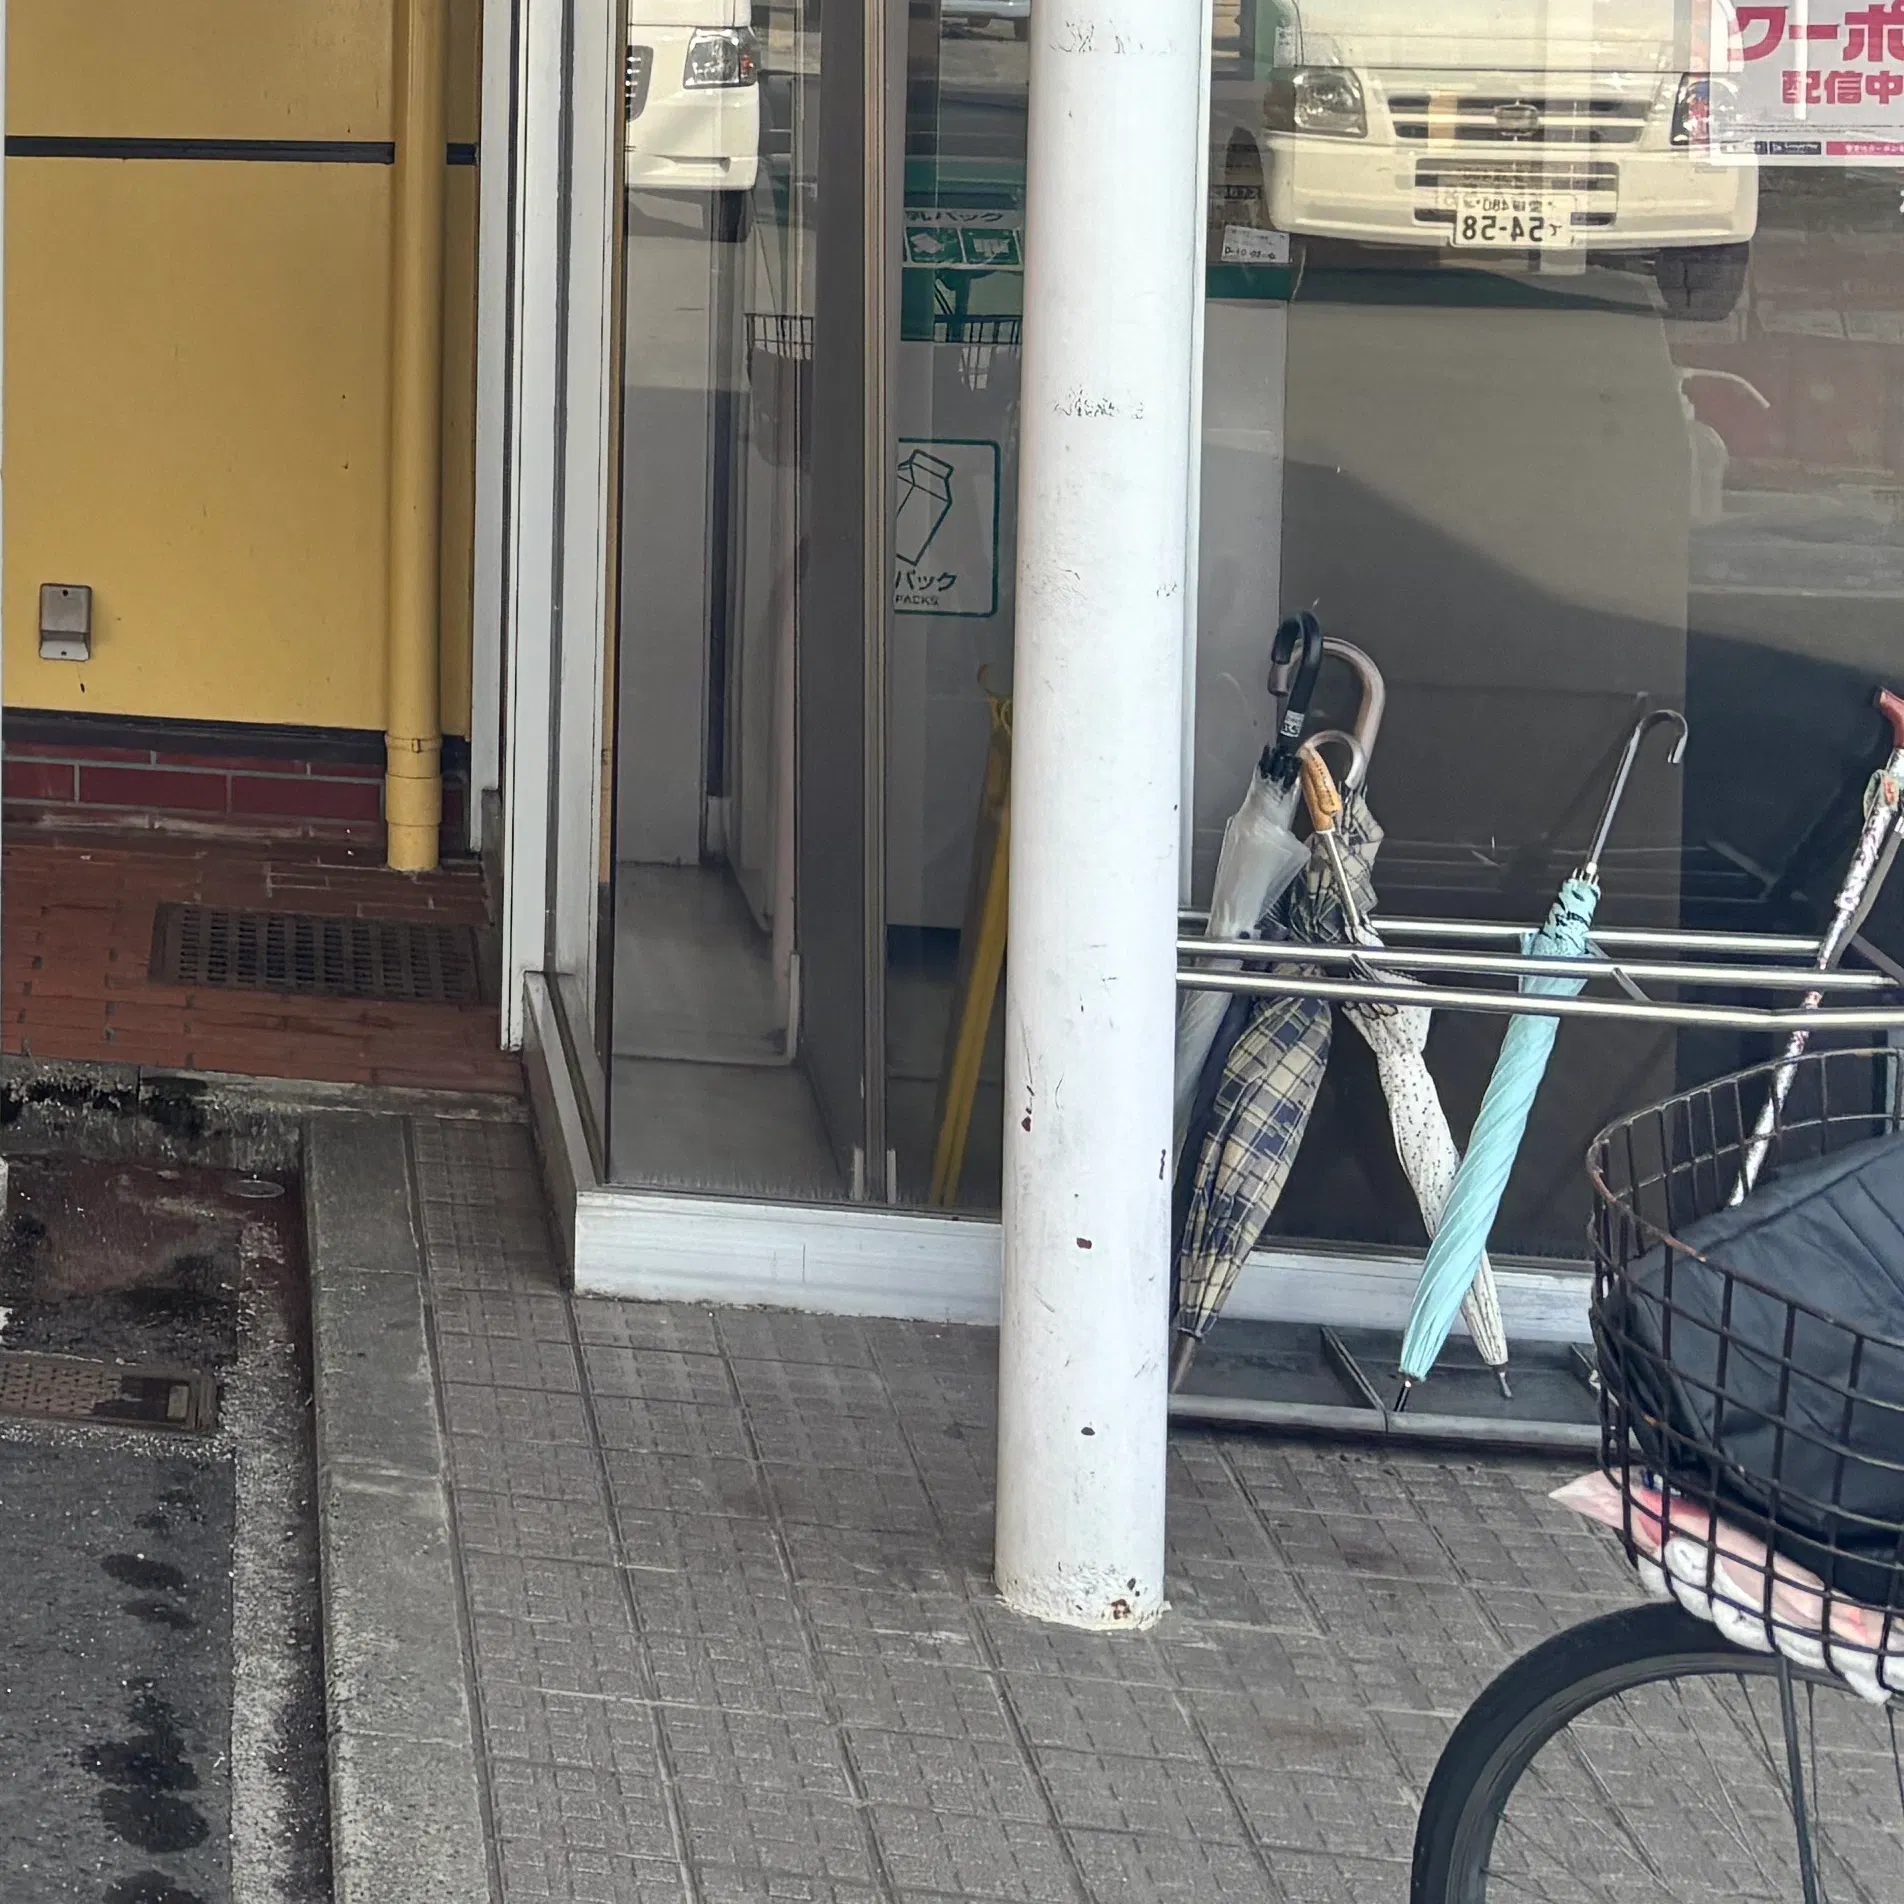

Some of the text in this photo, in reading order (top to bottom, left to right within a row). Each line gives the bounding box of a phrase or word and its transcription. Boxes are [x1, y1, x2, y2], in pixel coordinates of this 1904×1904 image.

[1782, 70, 1904, 105] 配信中
[895, 570, 958, 592] パック
